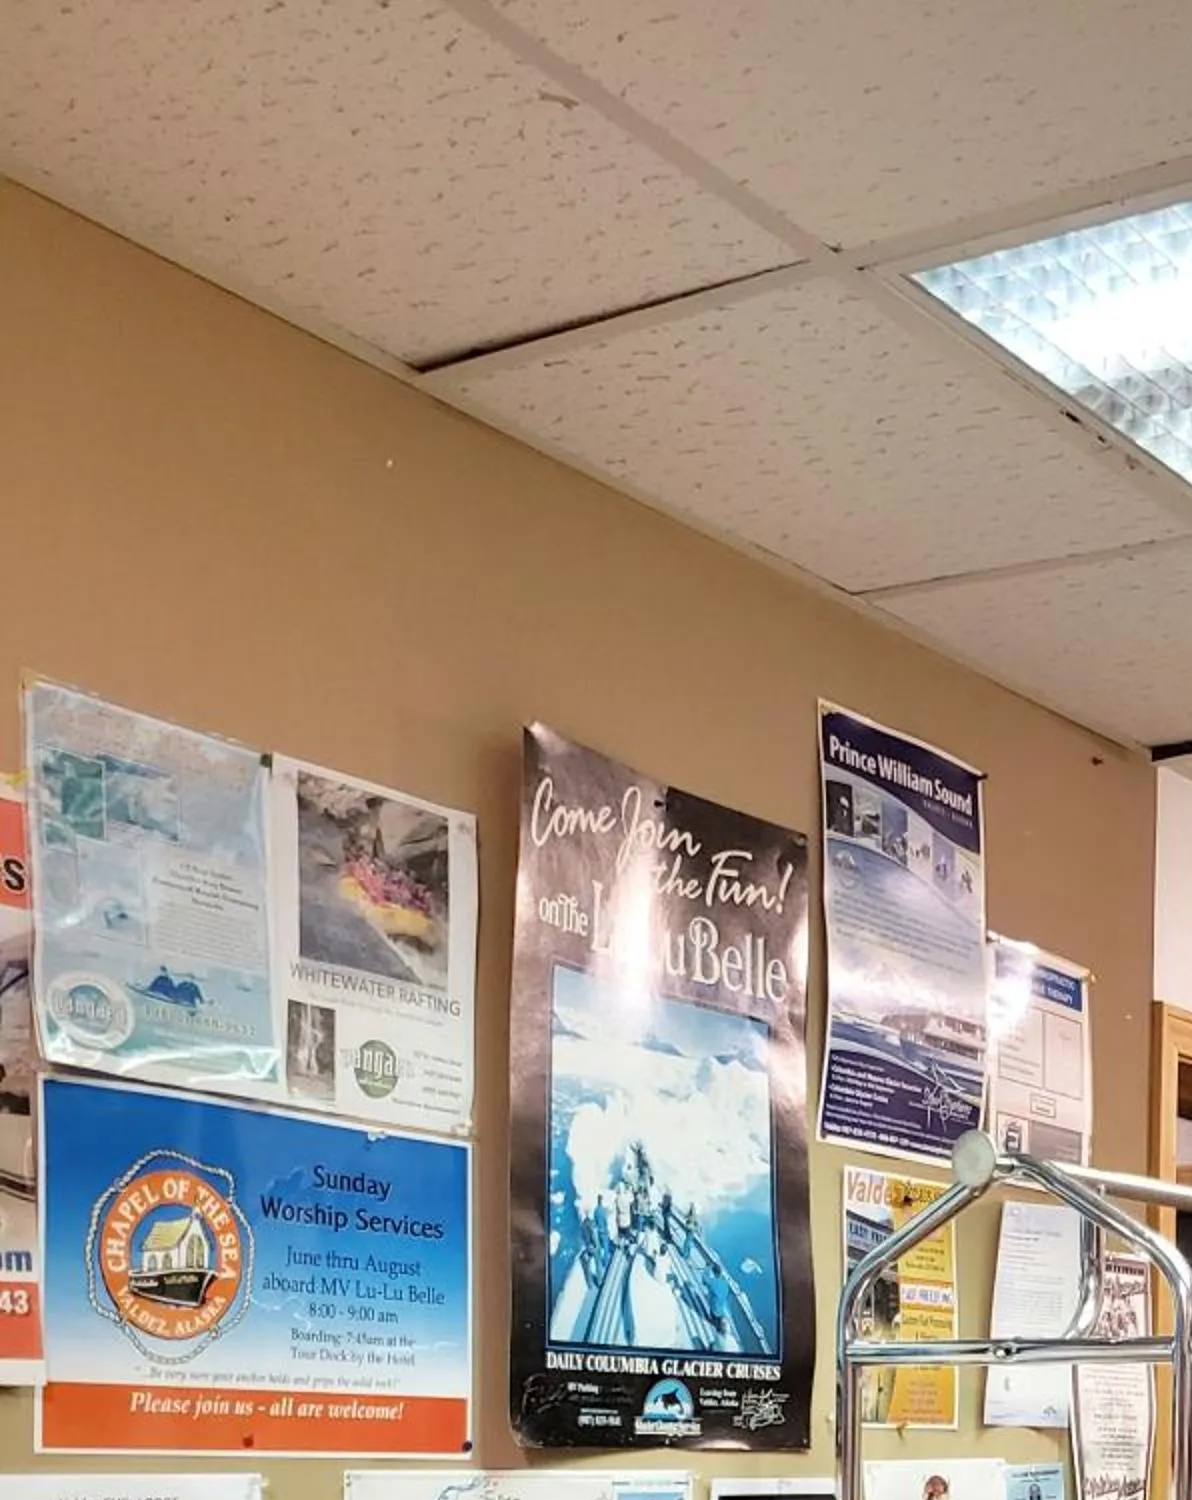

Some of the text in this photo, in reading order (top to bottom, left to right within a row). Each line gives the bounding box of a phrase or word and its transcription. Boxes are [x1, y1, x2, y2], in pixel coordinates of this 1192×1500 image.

[829, 735, 877, 775] Prince
[877, 754, 934, 798] William
[934, 779, 973, 816] Sound
[531, 777, 701, 869] Come Join
[650, 850, 793, 914] the Fun!
[689, 916, 788, 1002] Belle
[290, 961, 396, 999] WHITEWATER
[399, 987, 462, 1017] RAFTING
[313, 1164, 392, 1200] Sunday
[107, 1177, 240, 1280] CHAPEL OF THE SEA
[260, 1194, 444, 1240] Worship Services
[285, 1245, 422, 1279] June thru August
[262, 1271, 446, 1306] aboard MV Lu-Lu Belle
[118, 1285, 227, 1335] VALDEZ ALASKA
[308, 1302, 336, 1319] 8:00
[347, 1305, 375, 1323] 9:00
[377, 1312, 399, 1324] am
[290, 1327, 342, 1346] Boarding
[386, 1335, 398, 1347] at
[399, 1335, 416, 1348] the
[291, 1347, 317, 1360] Tour
[319, 1348, 346, 1362] Dock
[348, 1351, 364, 1367] by
[366, 1350, 384, 1364] the
[546, 1351, 781, 1382] DAILY COLUMBIA GLACIER CRUISES
[129, 1391, 191, 1415] Please
[192, 1393, 229, 1421] join
[234, 1401, 253, 1416] us
[269, 1396, 293, 1418] all
[297, 1402, 324, 1419] are
[328, 1399, 405, 1421] welcome!
